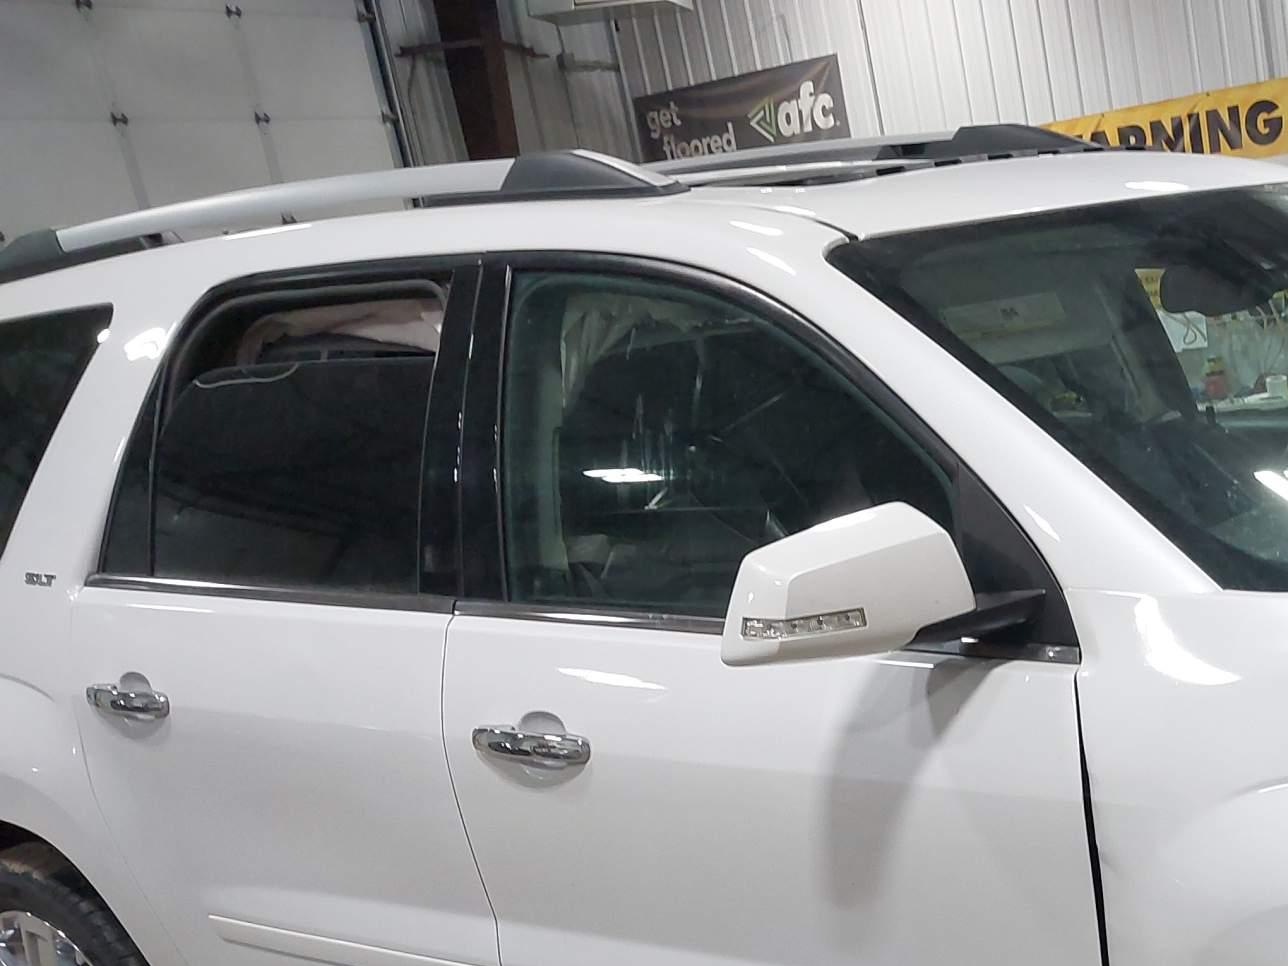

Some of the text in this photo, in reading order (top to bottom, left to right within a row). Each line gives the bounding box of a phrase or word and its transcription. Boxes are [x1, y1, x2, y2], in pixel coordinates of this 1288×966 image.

[647, 101, 682, 139] get
[777, 80, 835, 137] afc
[1072, 100, 1283, 154] RNING
[663, 121, 737, 160] floored
[24, 571, 57, 587] SLT
